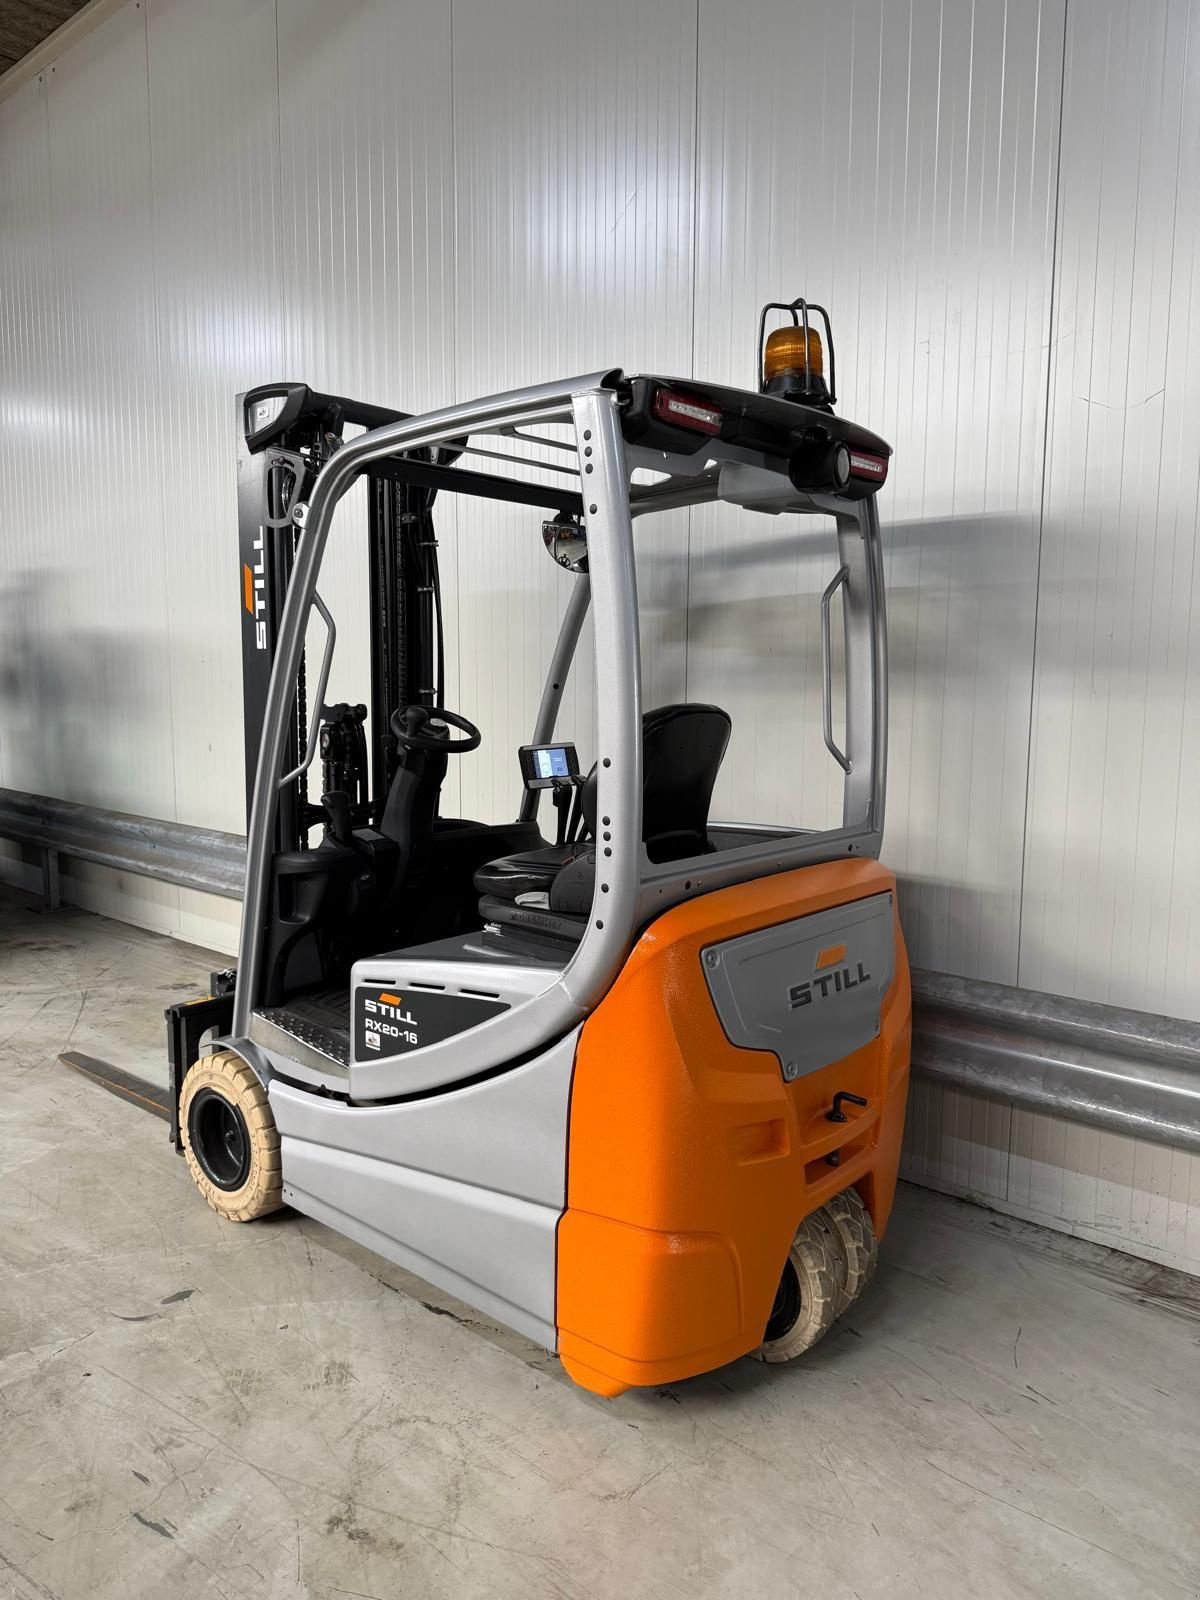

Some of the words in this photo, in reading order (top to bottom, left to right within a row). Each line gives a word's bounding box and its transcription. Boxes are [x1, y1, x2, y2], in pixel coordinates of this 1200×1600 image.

[253, 525, 266, 649] STILL
[789, 962, 871, 1009] STILL
[364, 999, 418, 1026] STILL
[365, 1018, 418, 1045] RX20-16
